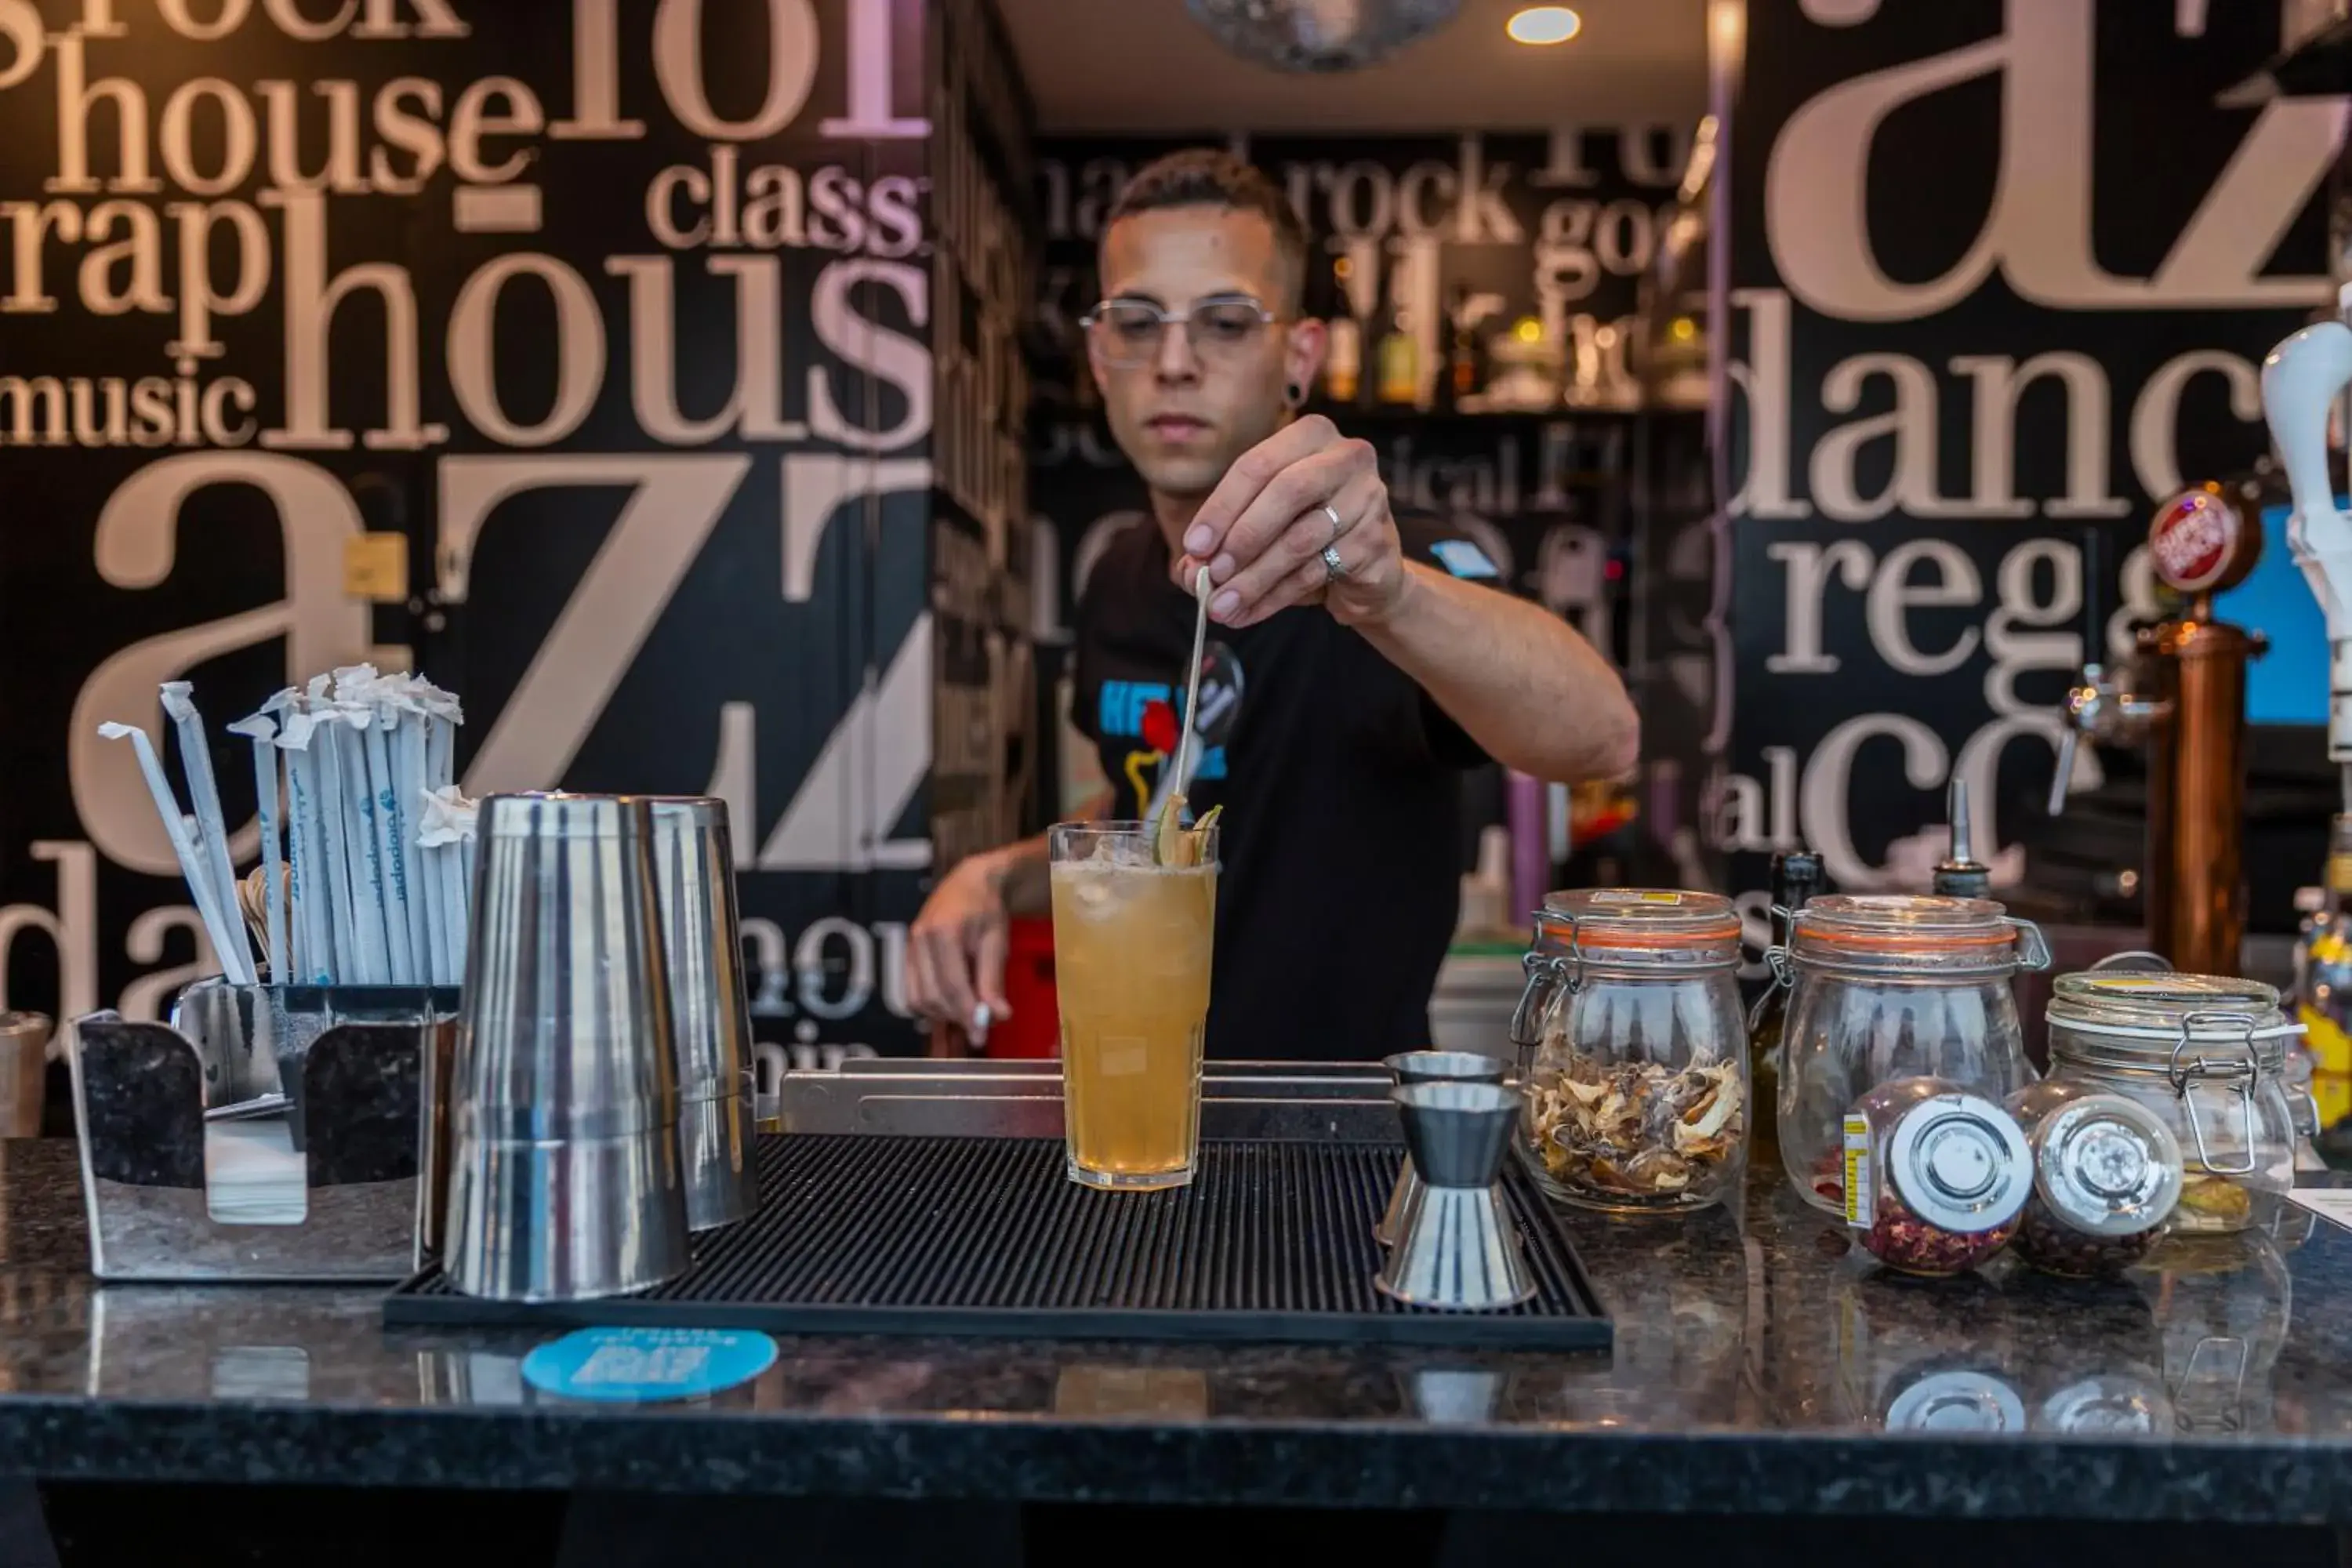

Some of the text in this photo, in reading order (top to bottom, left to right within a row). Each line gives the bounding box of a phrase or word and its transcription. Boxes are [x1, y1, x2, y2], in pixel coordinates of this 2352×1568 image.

[44, 31, 545, 195] house
[645, 143, 931, 257] class
[1283, 129, 1523, 245] rock
[0, 199, 271, 358] rap
[0, 357, 258, 448] music
